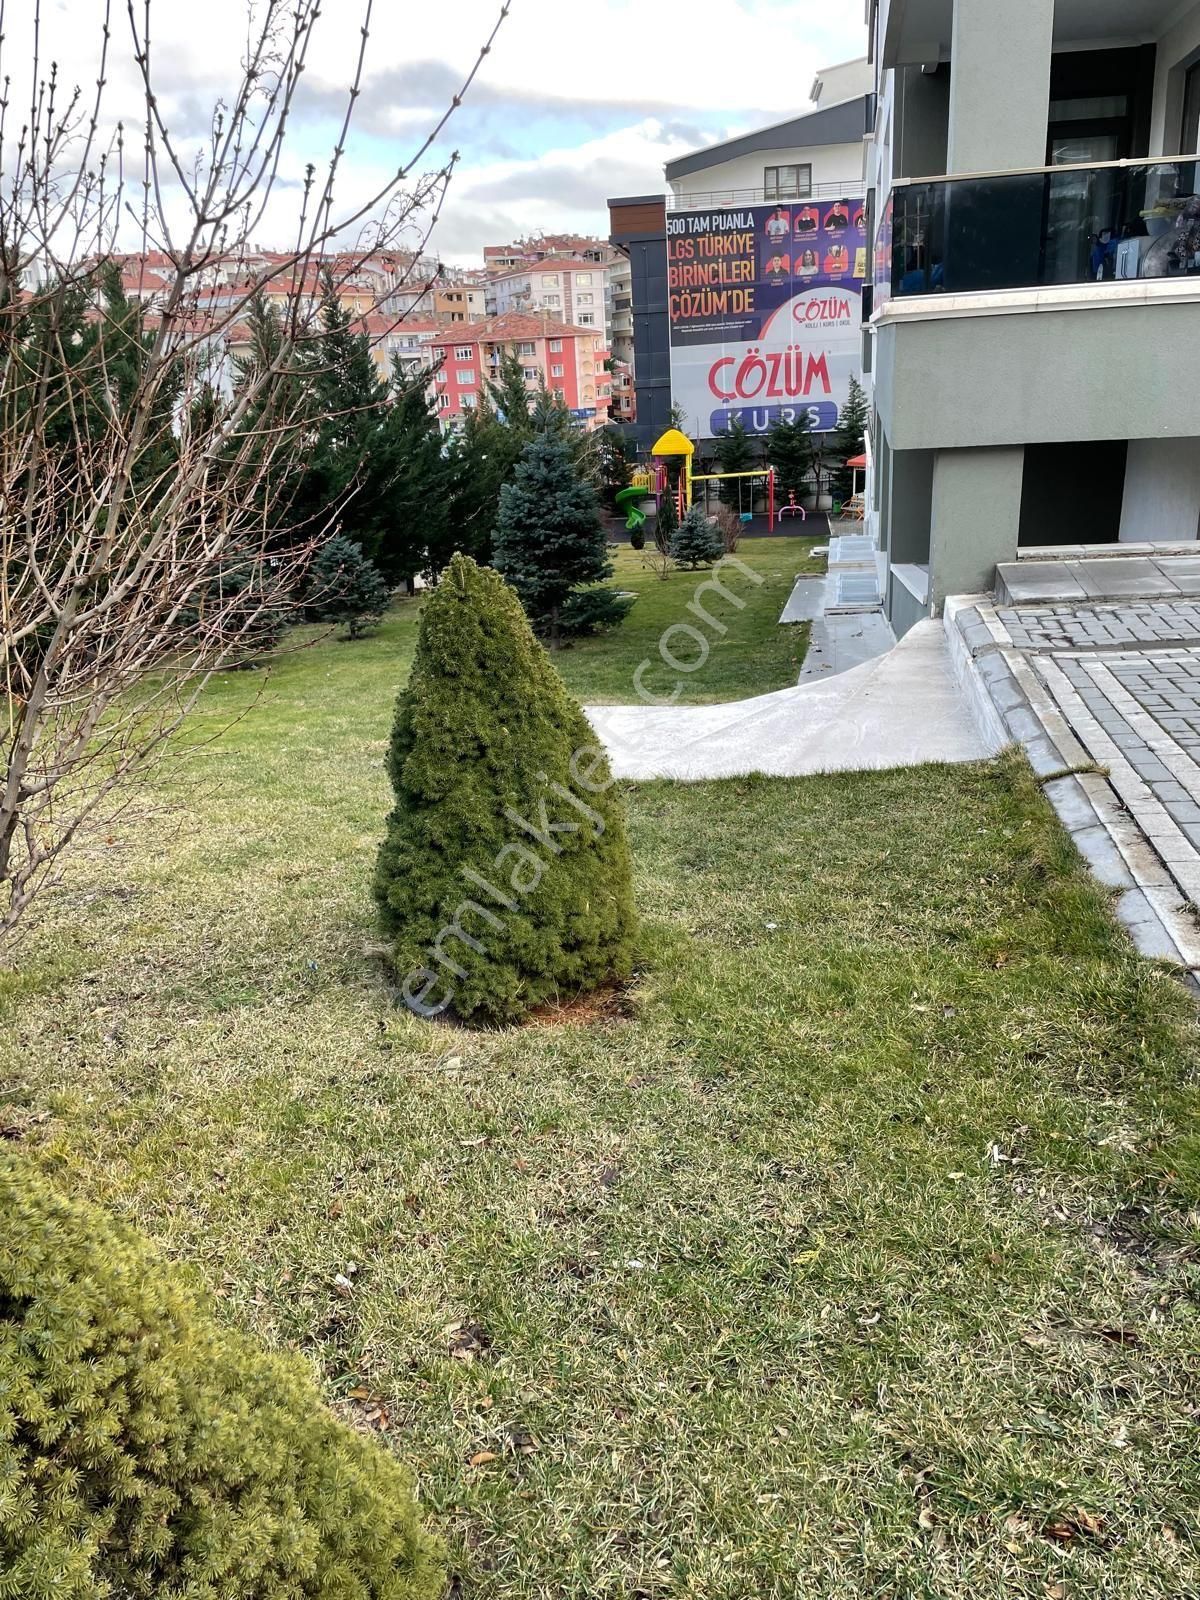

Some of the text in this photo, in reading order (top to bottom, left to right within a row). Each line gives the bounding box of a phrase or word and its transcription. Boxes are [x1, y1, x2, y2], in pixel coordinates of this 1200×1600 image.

[667, 212, 754, 235] 500 TAM PUANLA
[668, 230, 754, 260] LGS TÜRKİYE
[669, 255, 755, 288] BİRİNCİLERİ
[670, 287, 755, 323] ÇÖZÜM'DE
[792, 296, 851, 323] ÇÖZÜM
[708, 344, 832, 404] ÇÖZÜM
[727, 406, 820, 431] KURS
